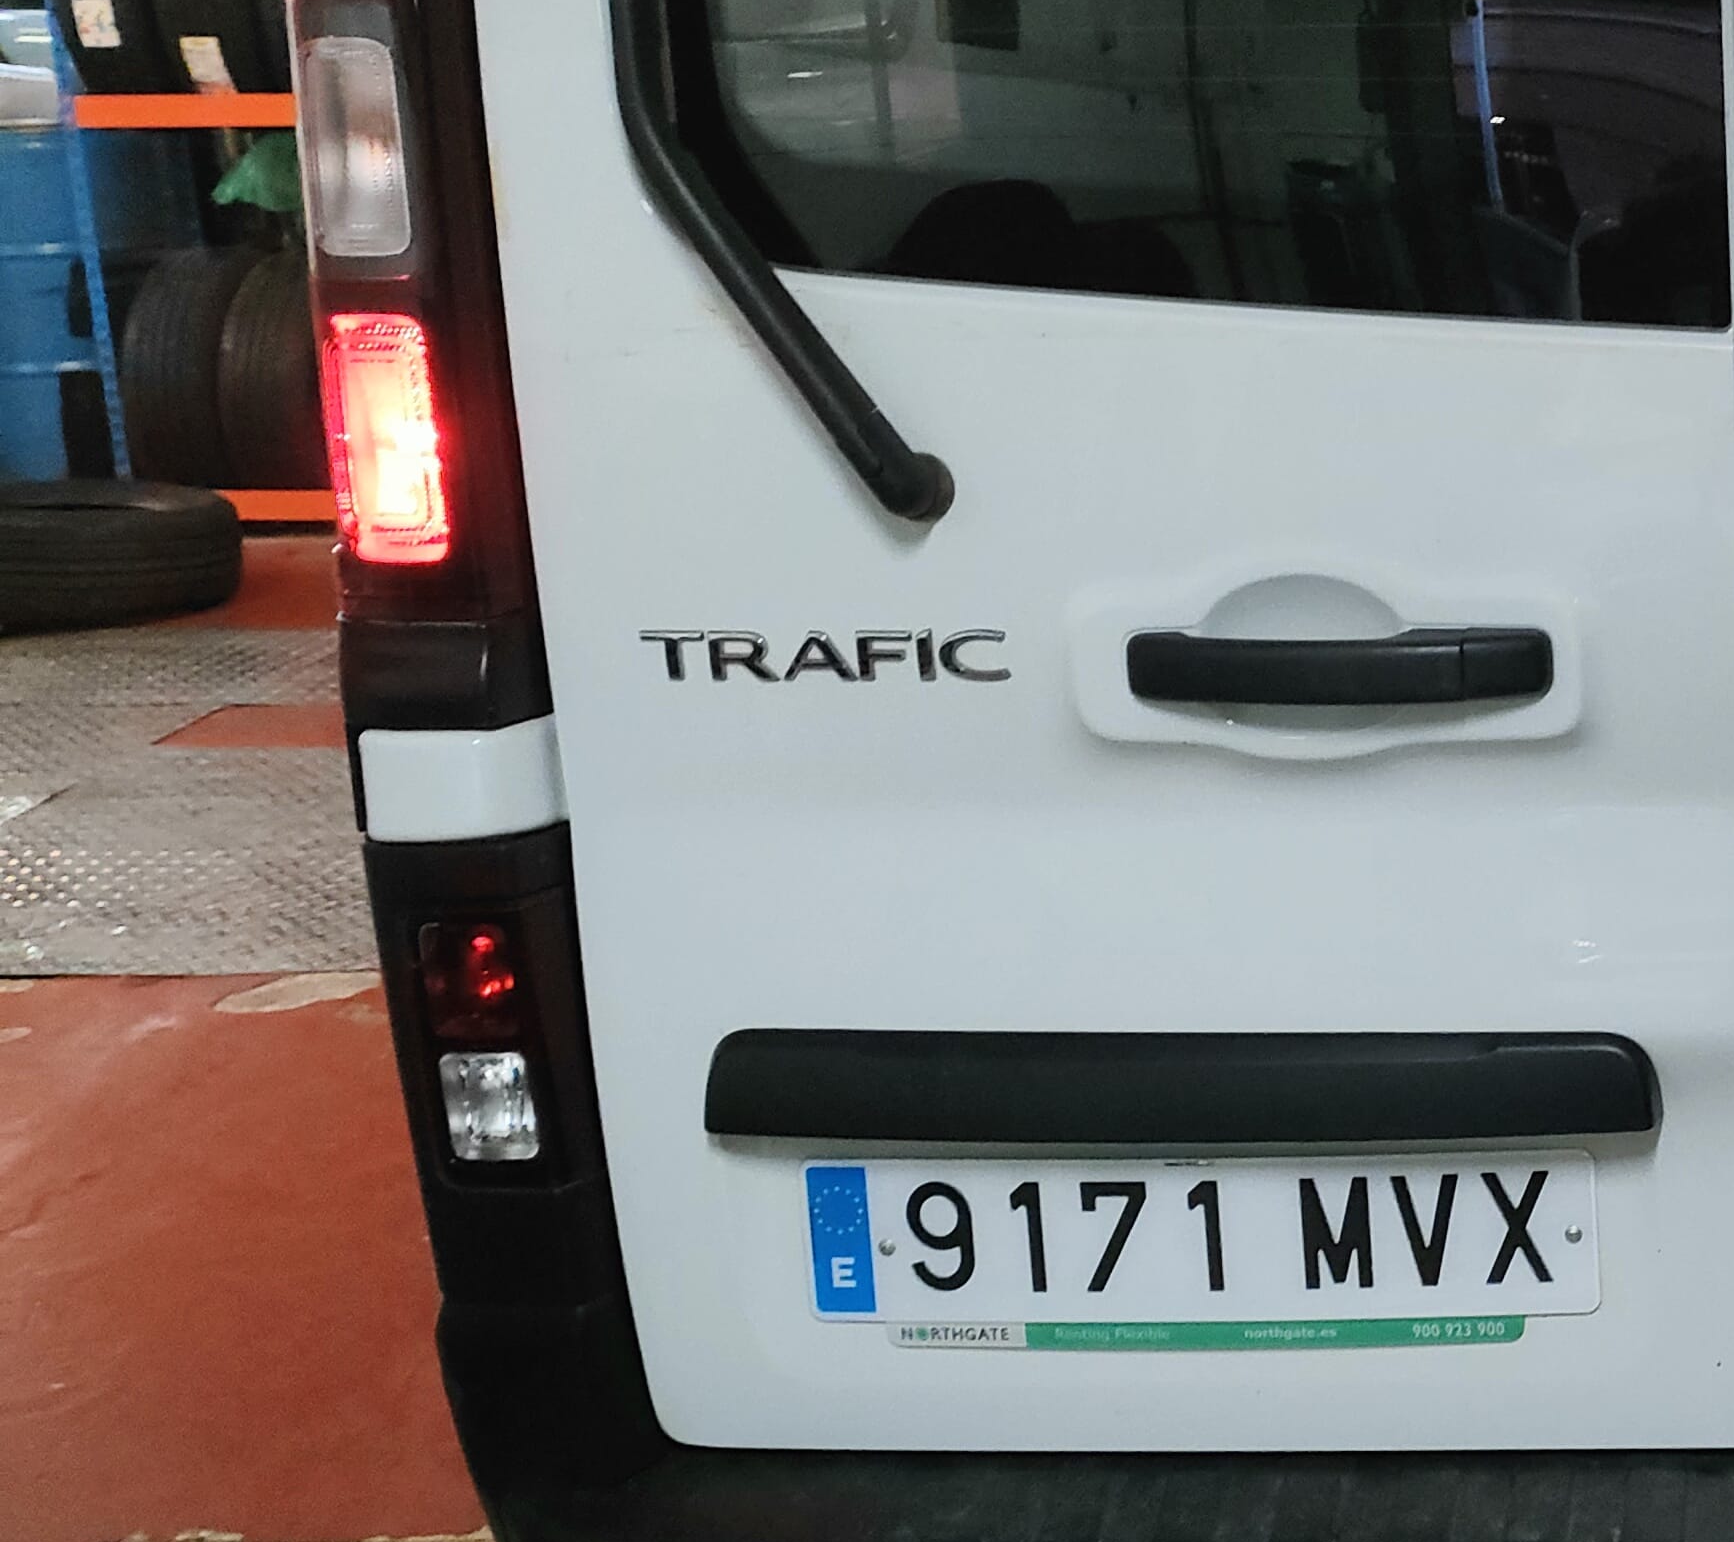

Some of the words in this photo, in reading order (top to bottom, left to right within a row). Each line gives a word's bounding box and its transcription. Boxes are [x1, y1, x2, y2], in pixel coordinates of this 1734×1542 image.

[639, 628, 1012, 681] TRAFIC
[905, 1181, 1226, 1293] 9171
[1300, 1170, 1553, 1290] MVX
[831, 1257, 857, 1288] E
[900, 1327, 1010, 1341] NORTHGATE
[1244, 1325, 1337, 1341] northgate.es
[1412, 1323, 1440, 1338] 900
[1445, 1322, 1472, 1337] 923
[1477, 1321, 1505, 1336] 900
